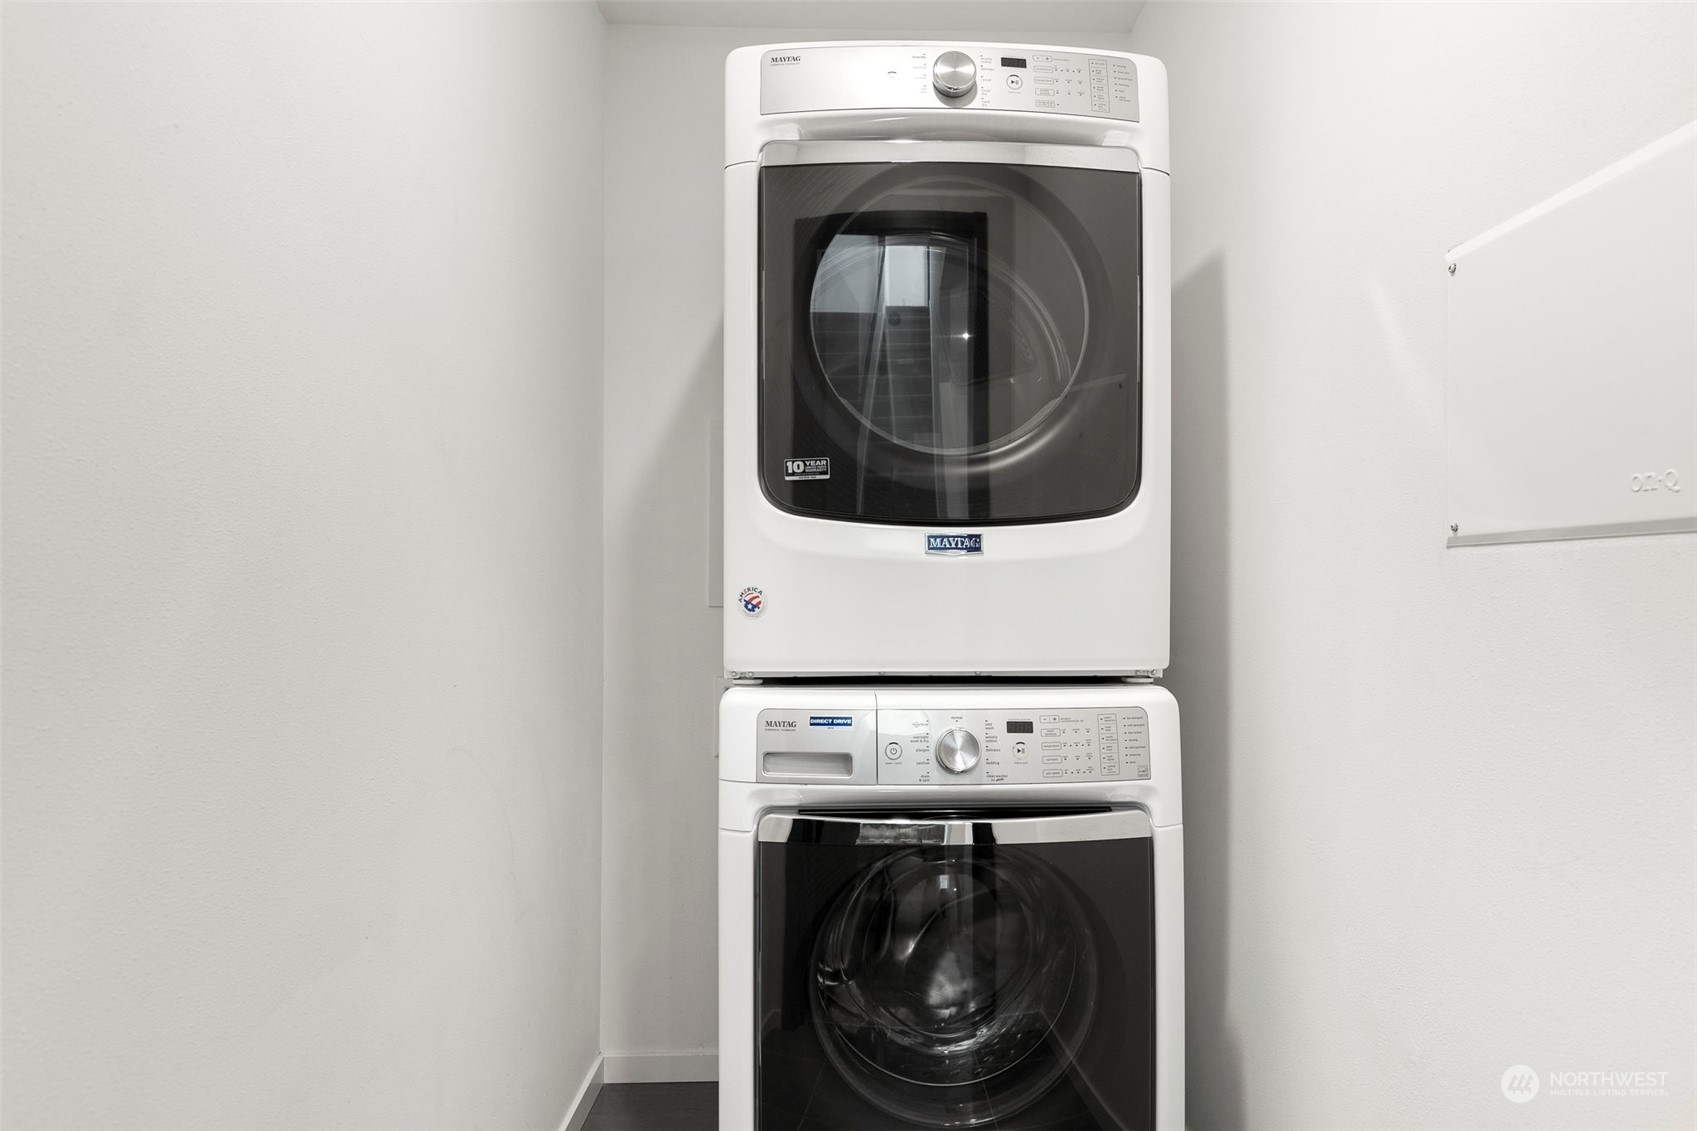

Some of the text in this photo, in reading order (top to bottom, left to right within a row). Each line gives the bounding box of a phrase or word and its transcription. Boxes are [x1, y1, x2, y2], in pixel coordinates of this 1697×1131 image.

[771, 55, 801, 63] MAYTAG
[786, 461, 804, 473] 10
[929, 537, 980, 548] MAYTAG
[738, 587, 762, 603] AMERICA
[765, 720, 797, 728] MAYTAG
